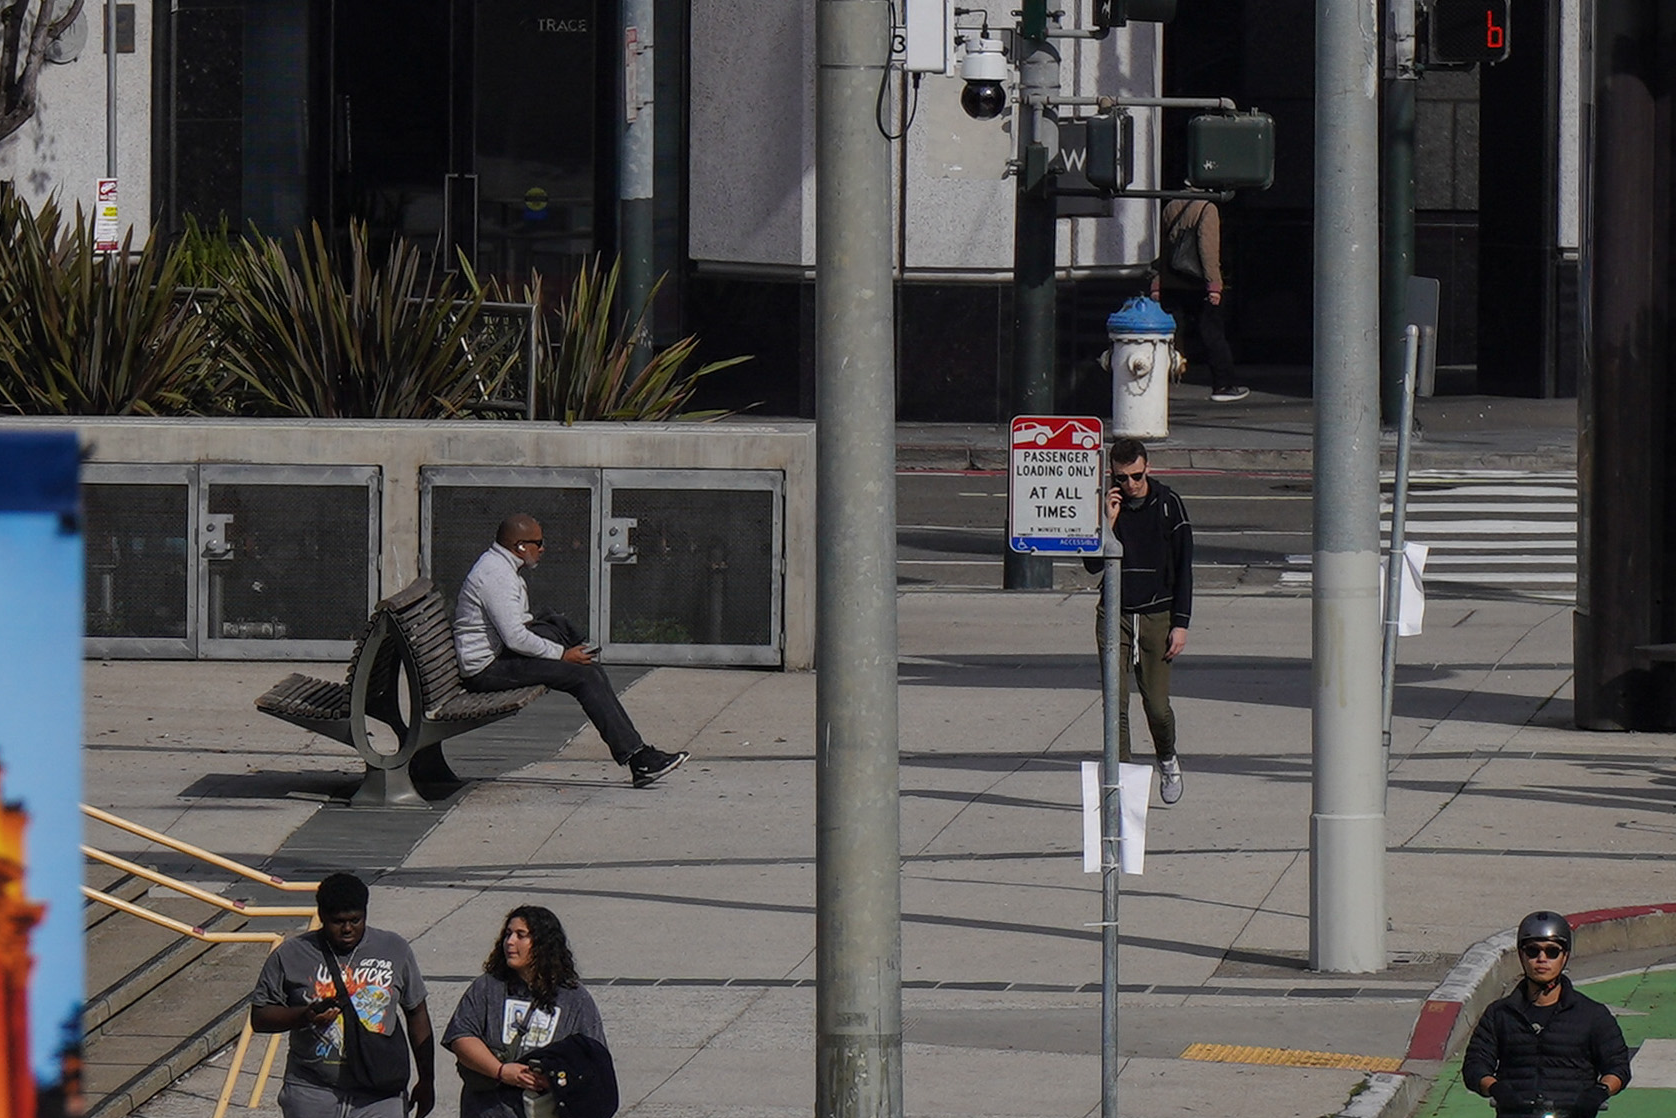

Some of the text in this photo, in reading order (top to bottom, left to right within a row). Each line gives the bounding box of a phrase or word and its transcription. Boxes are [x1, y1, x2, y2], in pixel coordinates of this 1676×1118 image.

[537, 18, 586, 32] TRACE
[1023, 451, 1089, 463] PASSENGER
[1016, 465, 1096, 477] LOADING ONLY
[1029, 486, 1083, 500] AT ALL
[1035, 505, 1077, 519] TIMES
[1060, 539, 1098, 547] ACCESSIBLE
[351, 967, 394, 988] KICKS
